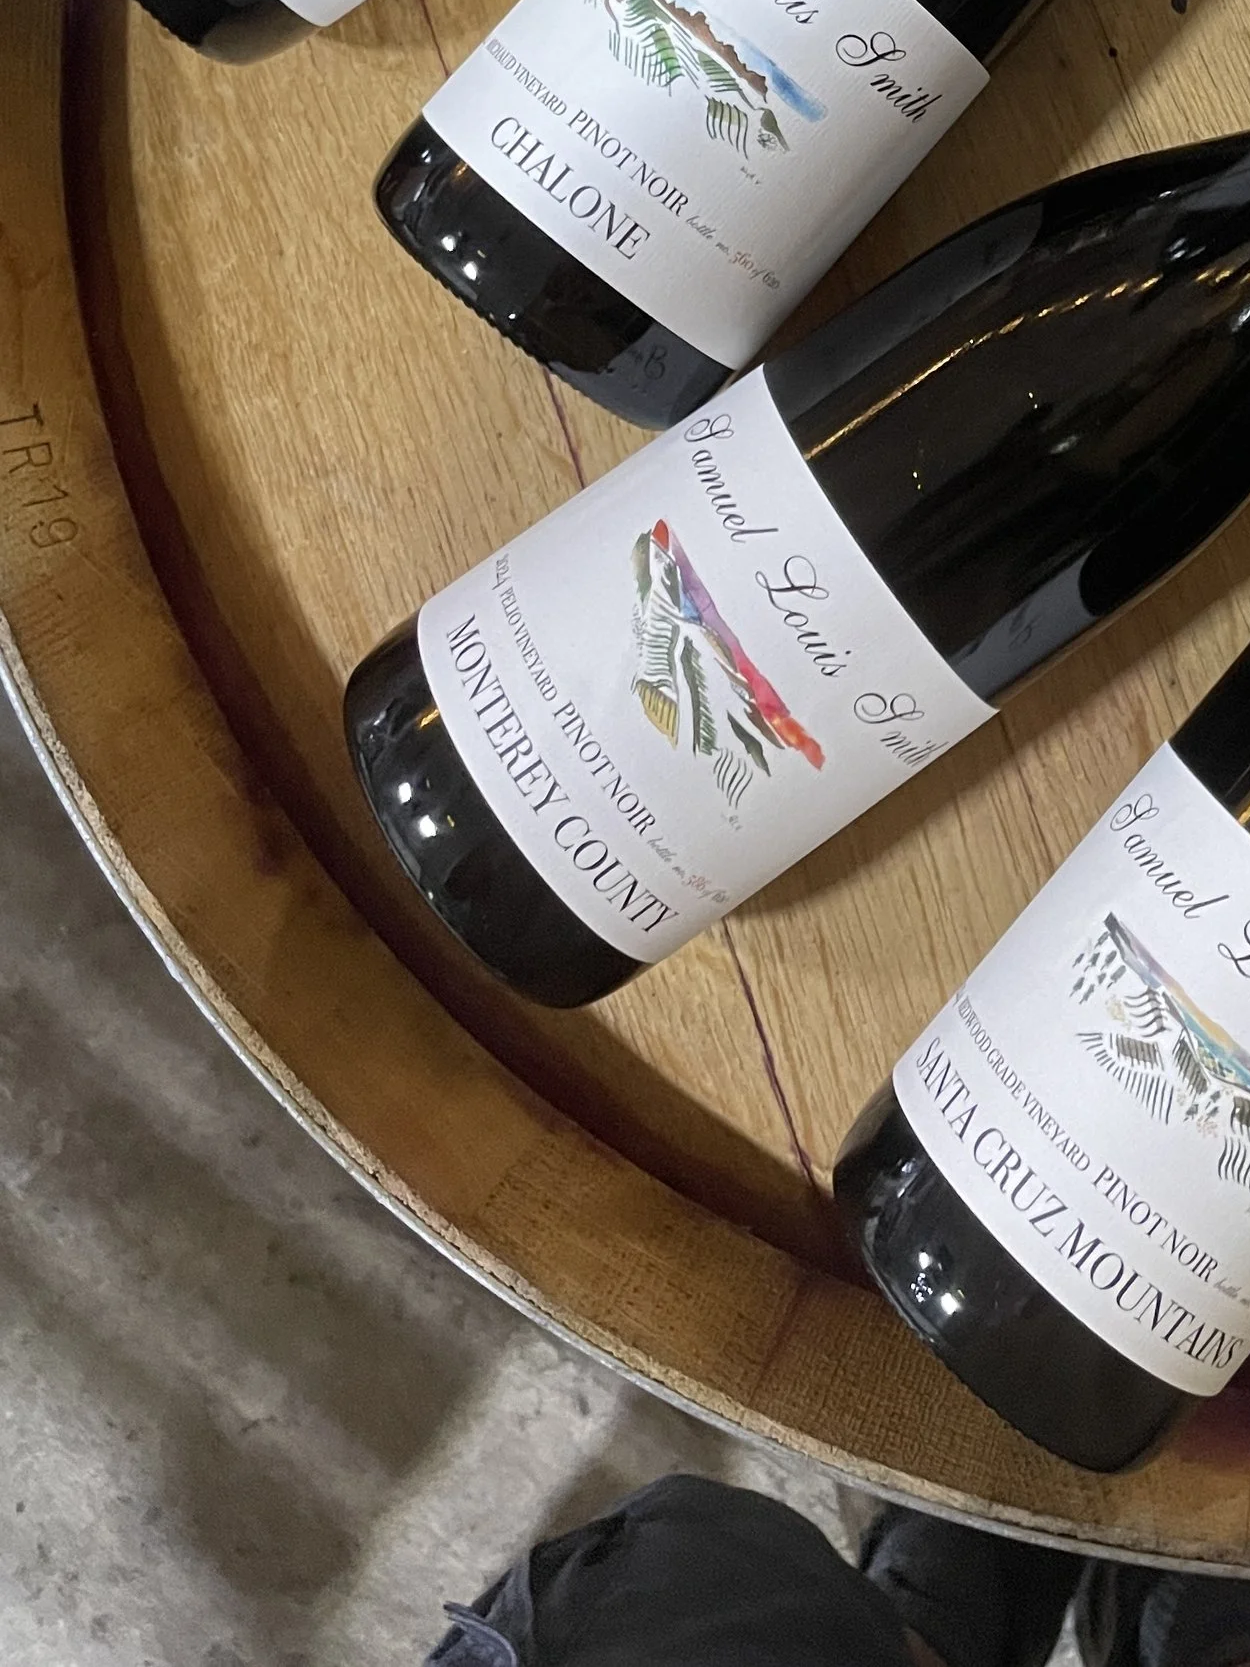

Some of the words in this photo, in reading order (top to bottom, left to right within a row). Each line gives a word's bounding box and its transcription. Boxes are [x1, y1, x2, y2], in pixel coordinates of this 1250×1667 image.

[514, 63, 568, 117] VINEYARD
[567, 108, 638, 171] PINOT
[628, 160, 690, 217] NOIR
[685, 214, 716, 241] bottle
[728, 249, 755, 271] 560
[835, 31, 942, 123] Smith
[490, 115, 652, 261] CHALONE
[0, 401, 79, 549] TR19
[684, 413, 779, 543] Samuel
[755, 555, 852, 678] Louis
[446, 613, 572, 817] MONTEREY
[554, 814, 681, 934] COUNTY
[500, 587, 522, 627] PELIO
[511, 623, 558, 703] VINEYARD
[552, 699, 613, 778] PINOT
[602, 773, 657, 836] NOIR
[1110, 793, 1230, 919] Samuel
[916, 1037, 980, 1143] SANTA
[972, 1127, 1069, 1238] CRUZ
[1054, 1217, 1246, 1371] MOUNTAINS
[985, 1050, 1022, 1100] GRADE
[1022, 1091, 1092, 1172] VINEYARD
[1092, 1163, 1169, 1238] PINOT
[1160, 1226, 1220, 1283] NOIR
